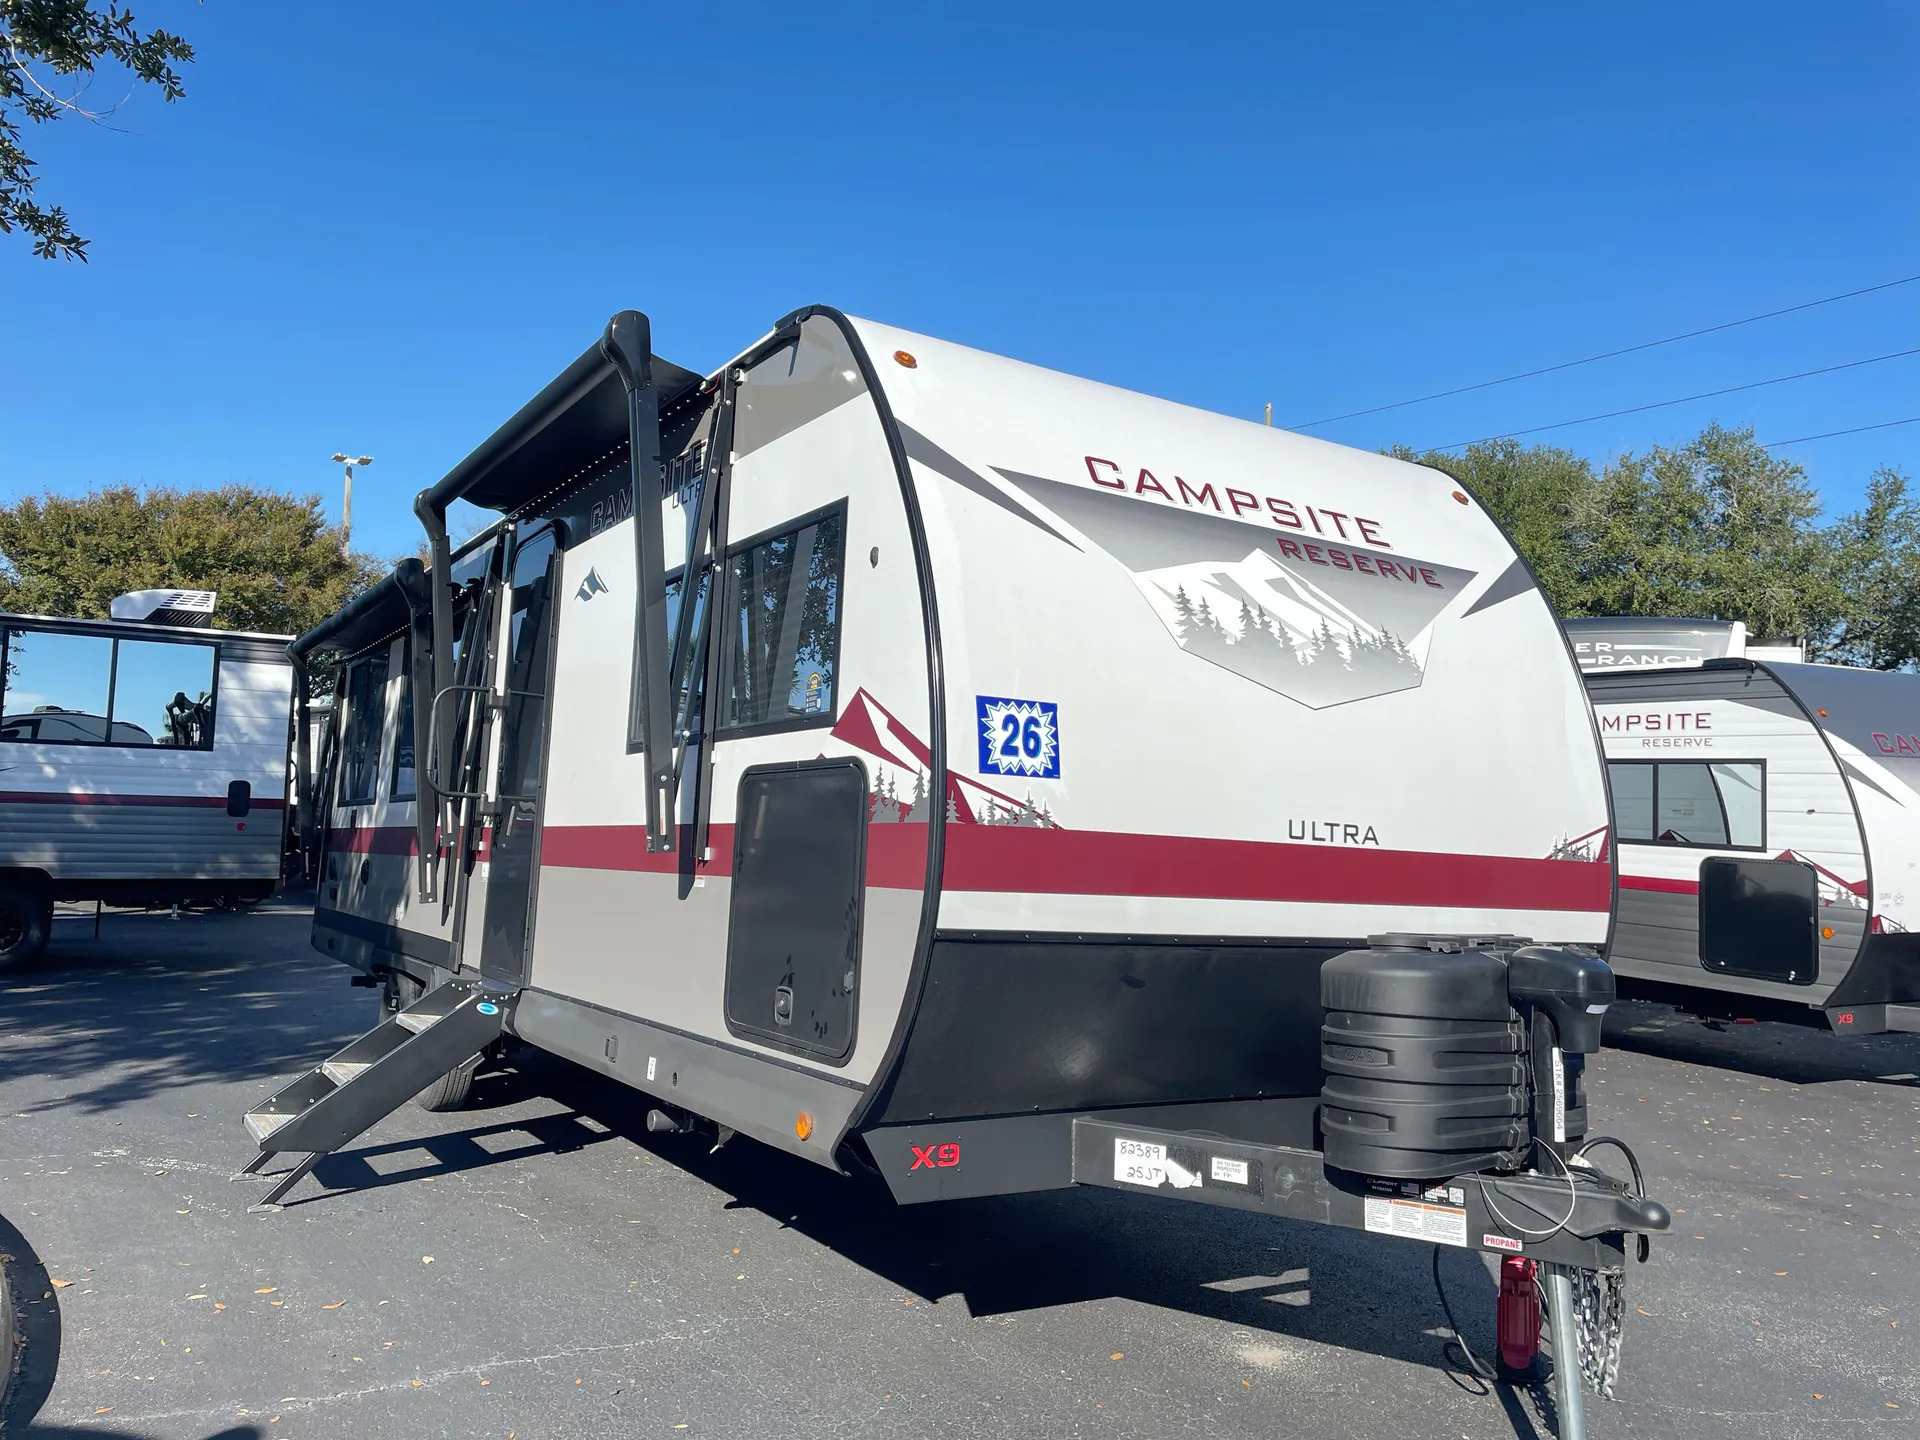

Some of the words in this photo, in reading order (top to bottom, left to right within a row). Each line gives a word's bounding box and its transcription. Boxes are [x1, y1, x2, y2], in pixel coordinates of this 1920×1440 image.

[589, 440, 707, 537] CAMITE
[672, 482, 702, 509] ULTR
[1084, 456, 1392, 548] CAMPSITE
[1276, 537, 1444, 589] RESERVE
[1597, 655, 1704, 665] RANCH
[1602, 712, 1712, 731] MPSITE
[1000, 713, 1042, 759] 26
[1642, 738, 1713, 747] RESERVE
[1288, 819, 1379, 845] ULTRA
[1838, 1013, 1853, 1025] X9
[1345, 1047, 1376, 1063] GAS
[909, 1143, 961, 1171] X9
[1120, 1141, 1161, 1159] 82389
[1127, 1166, 1162, 1180] 25JT
[1485, 1236, 1521, 1250] PROPANE
